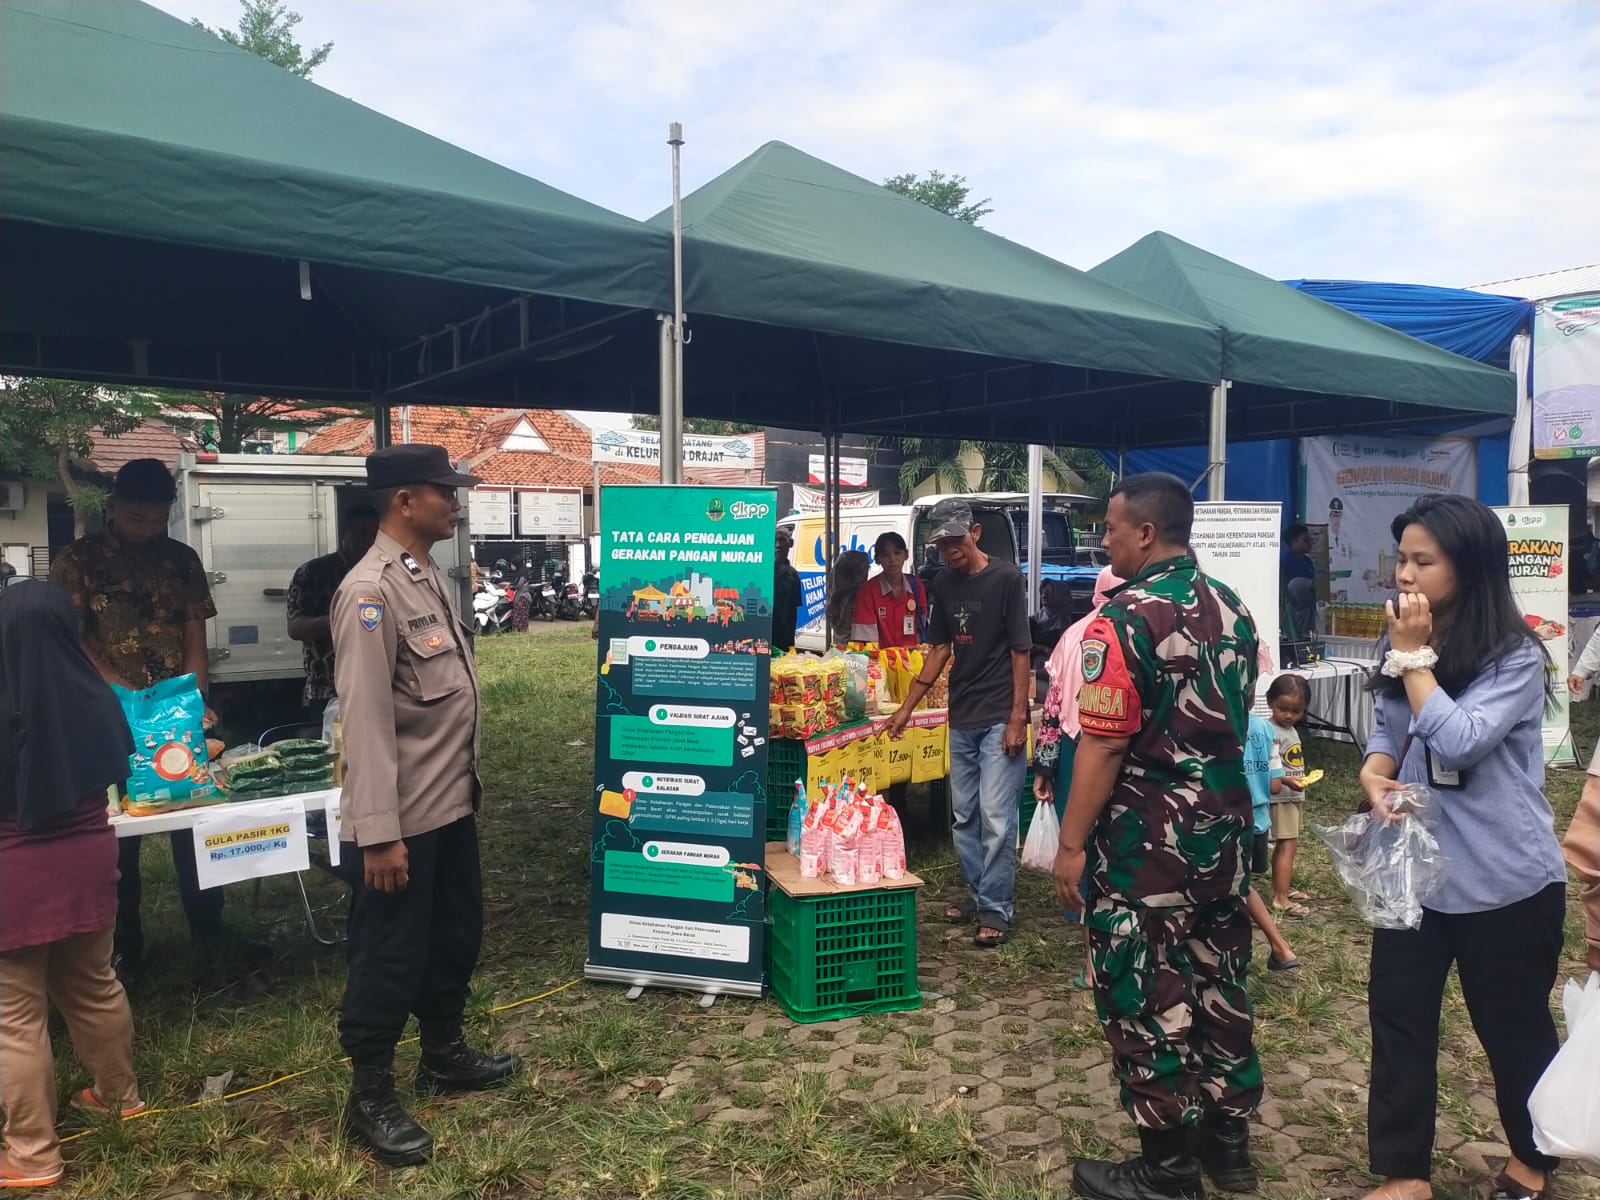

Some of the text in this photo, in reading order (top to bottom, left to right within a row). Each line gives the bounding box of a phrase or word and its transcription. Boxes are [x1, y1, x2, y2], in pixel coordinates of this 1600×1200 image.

[689, 450, 725, 462] DRAJAT
[730, 501, 769, 519] dkpp
[612, 531, 755, 545] TATA CARA PENGAJUAN
[611, 549, 763, 563] GERAKAN PANGAN MURAH
[1509, 554, 1551, 566] ANGAN
[801, 576, 823, 591] TELUR
[806, 588, 824, 607] AYAM
[660, 643, 698, 651] PENGAJUAN
[204, 825, 290, 847] GULA PASIR 1KG
[210, 850, 227, 861] Rp.
[274, 839, 287, 849] Kg
